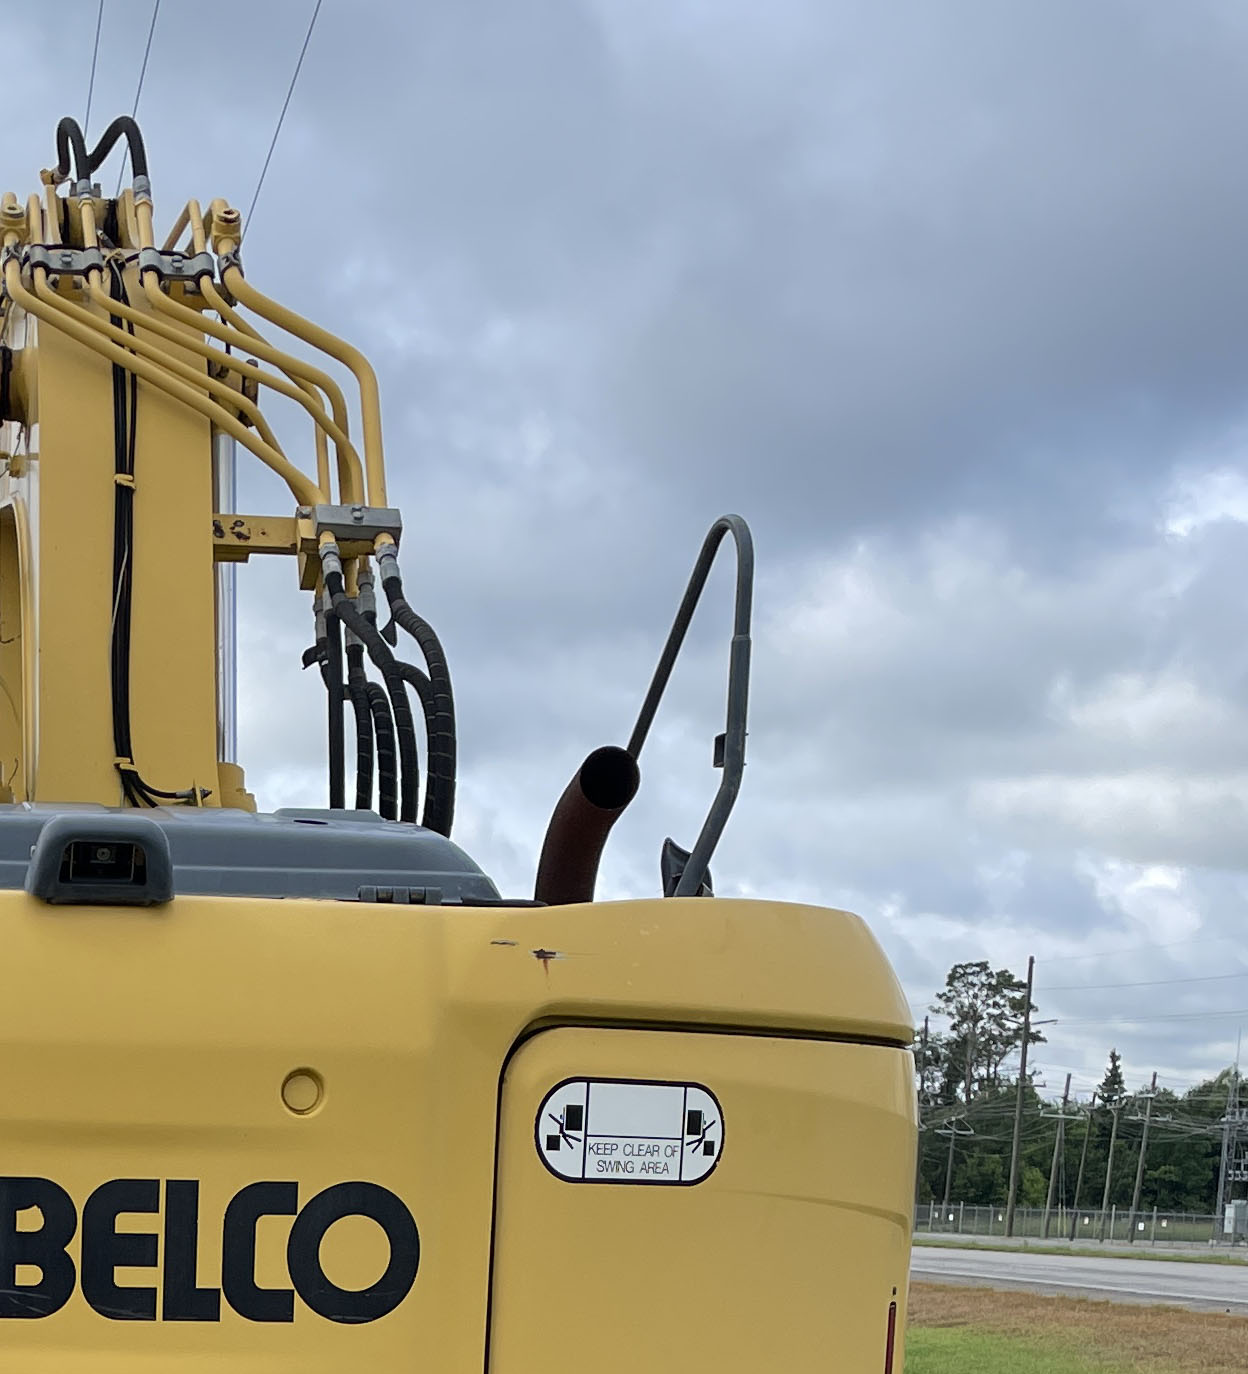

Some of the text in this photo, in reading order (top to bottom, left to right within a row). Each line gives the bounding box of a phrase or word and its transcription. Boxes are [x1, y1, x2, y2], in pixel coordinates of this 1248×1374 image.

[588, 1142, 680, 1158] KEEP CLEAR OF
[596, 1160, 670, 1175] SWING AREA
